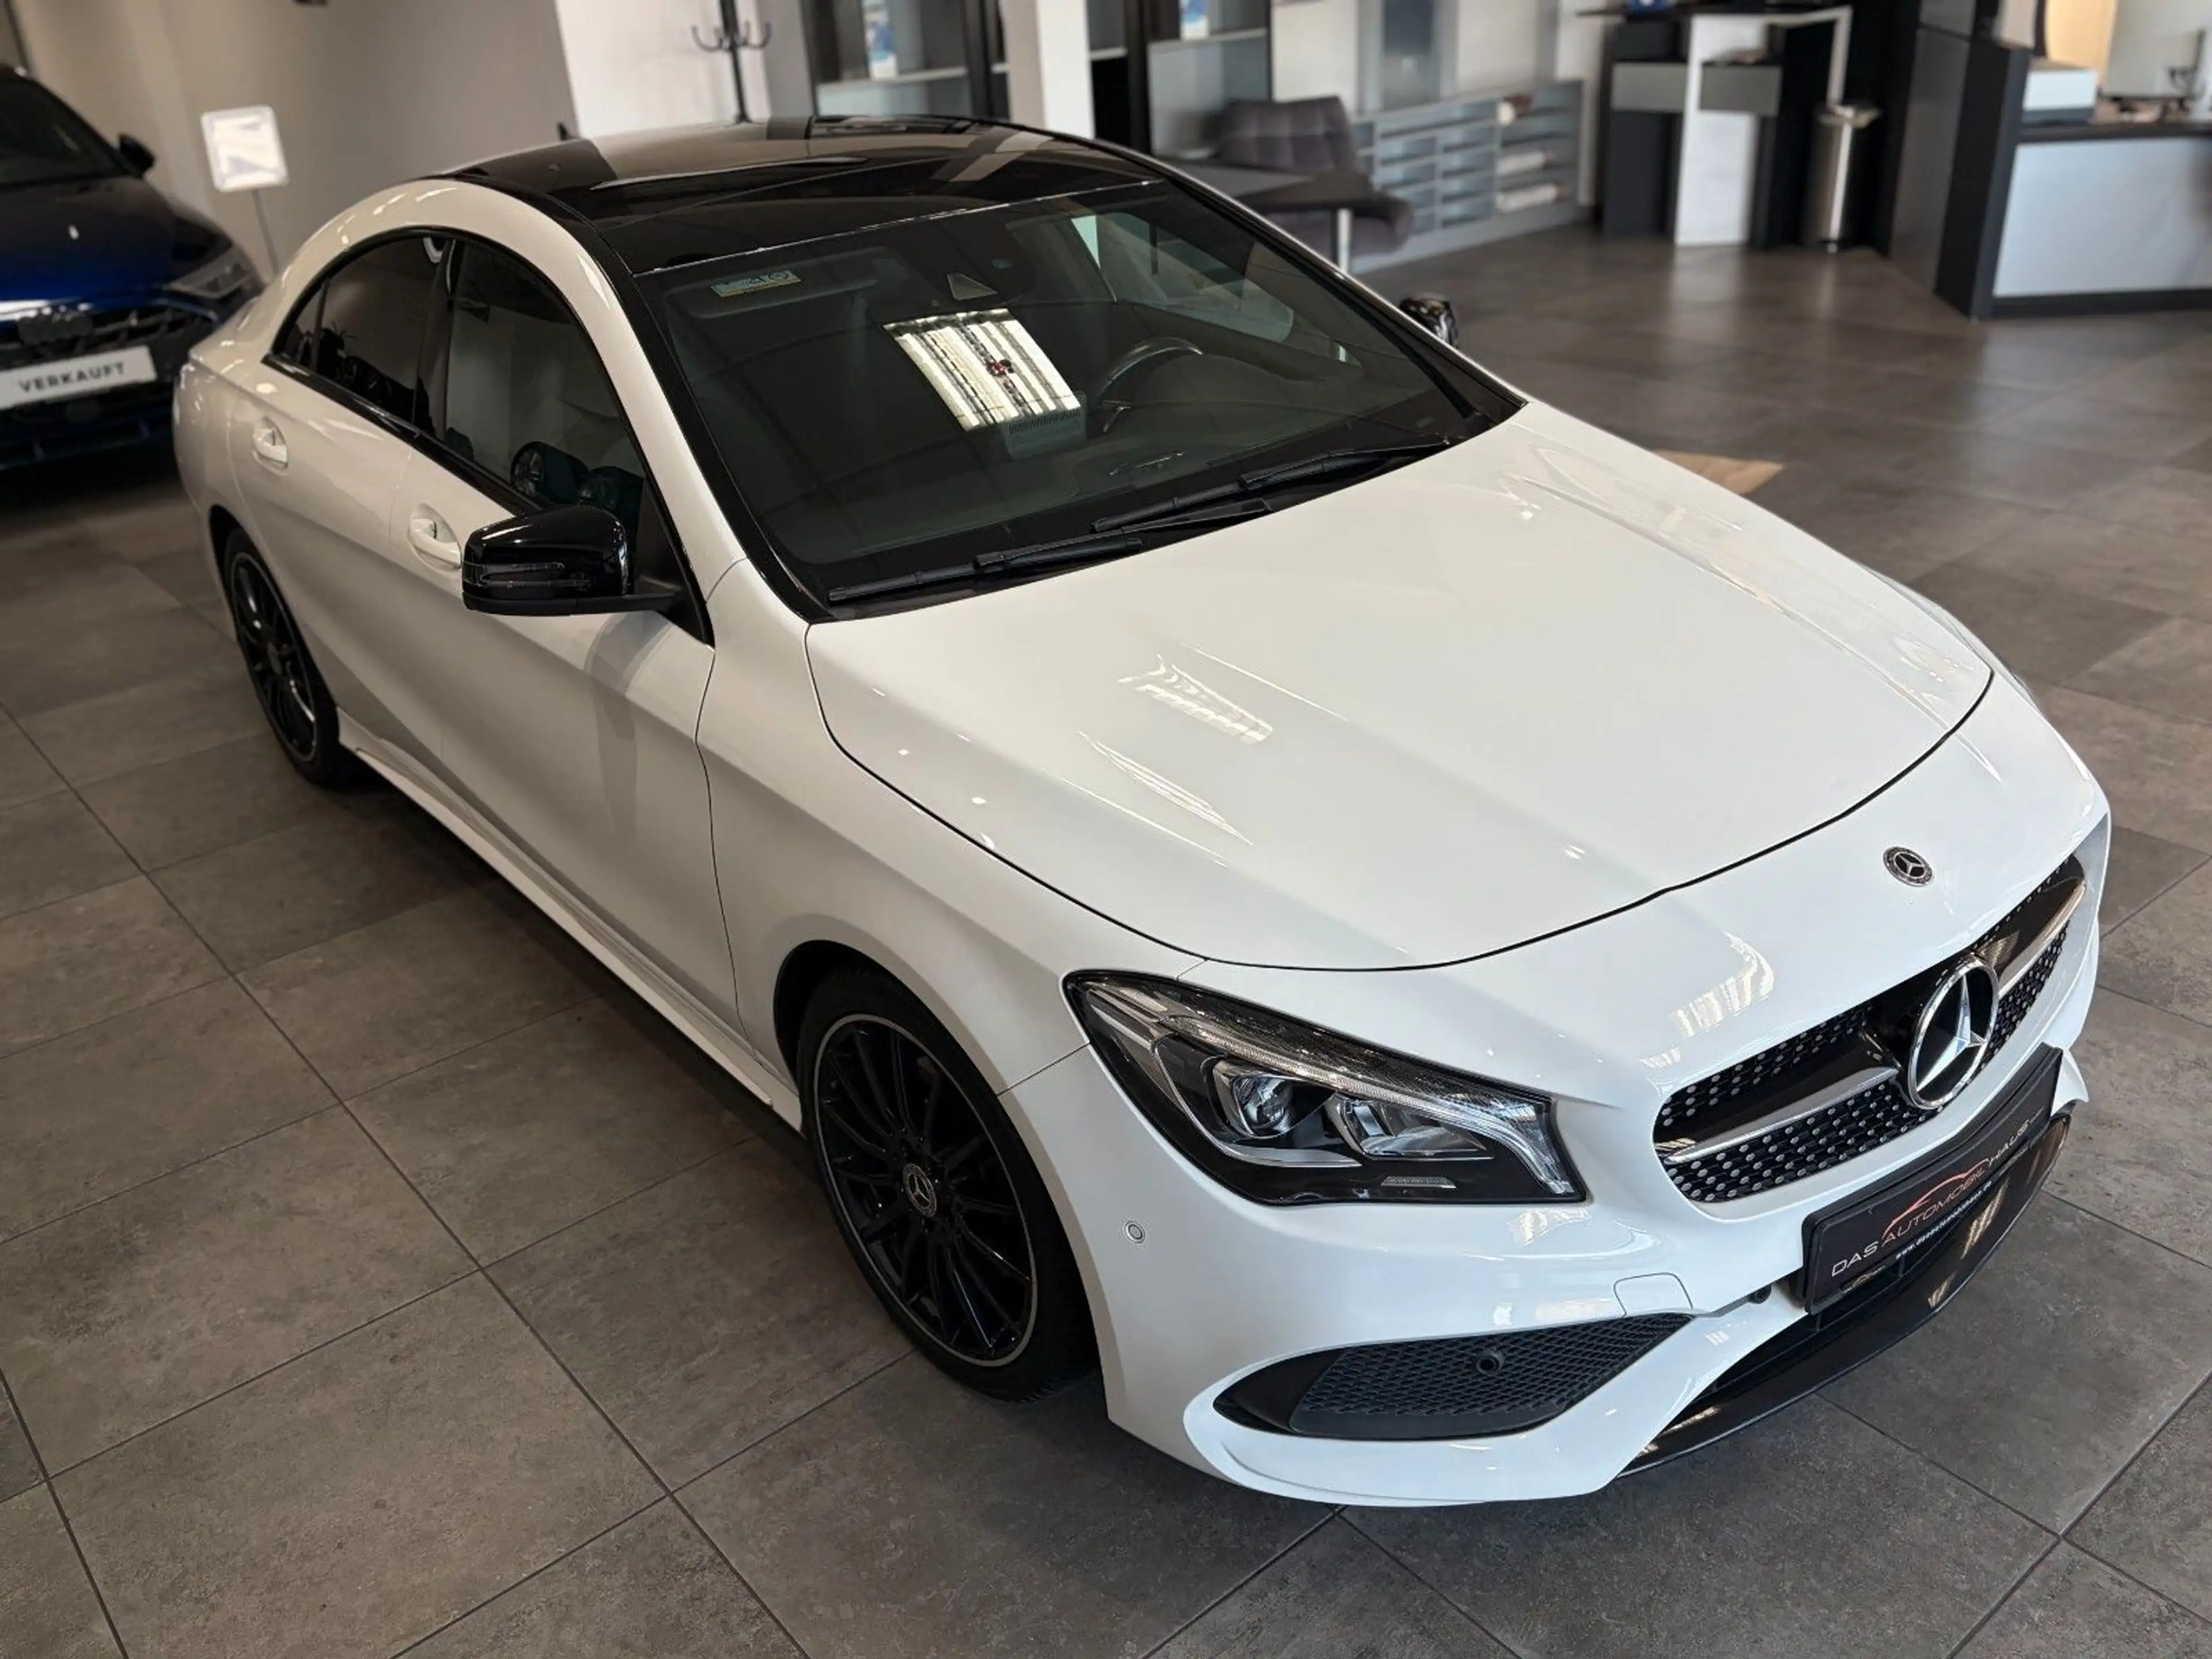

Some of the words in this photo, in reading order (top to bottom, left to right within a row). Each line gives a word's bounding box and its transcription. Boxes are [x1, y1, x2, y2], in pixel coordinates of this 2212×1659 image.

[18, 362, 124, 393] VERKAUFT
[1831, 1240, 1878, 1277] DAS
[1881, 1168, 1986, 1248] AUTOMOBIL
